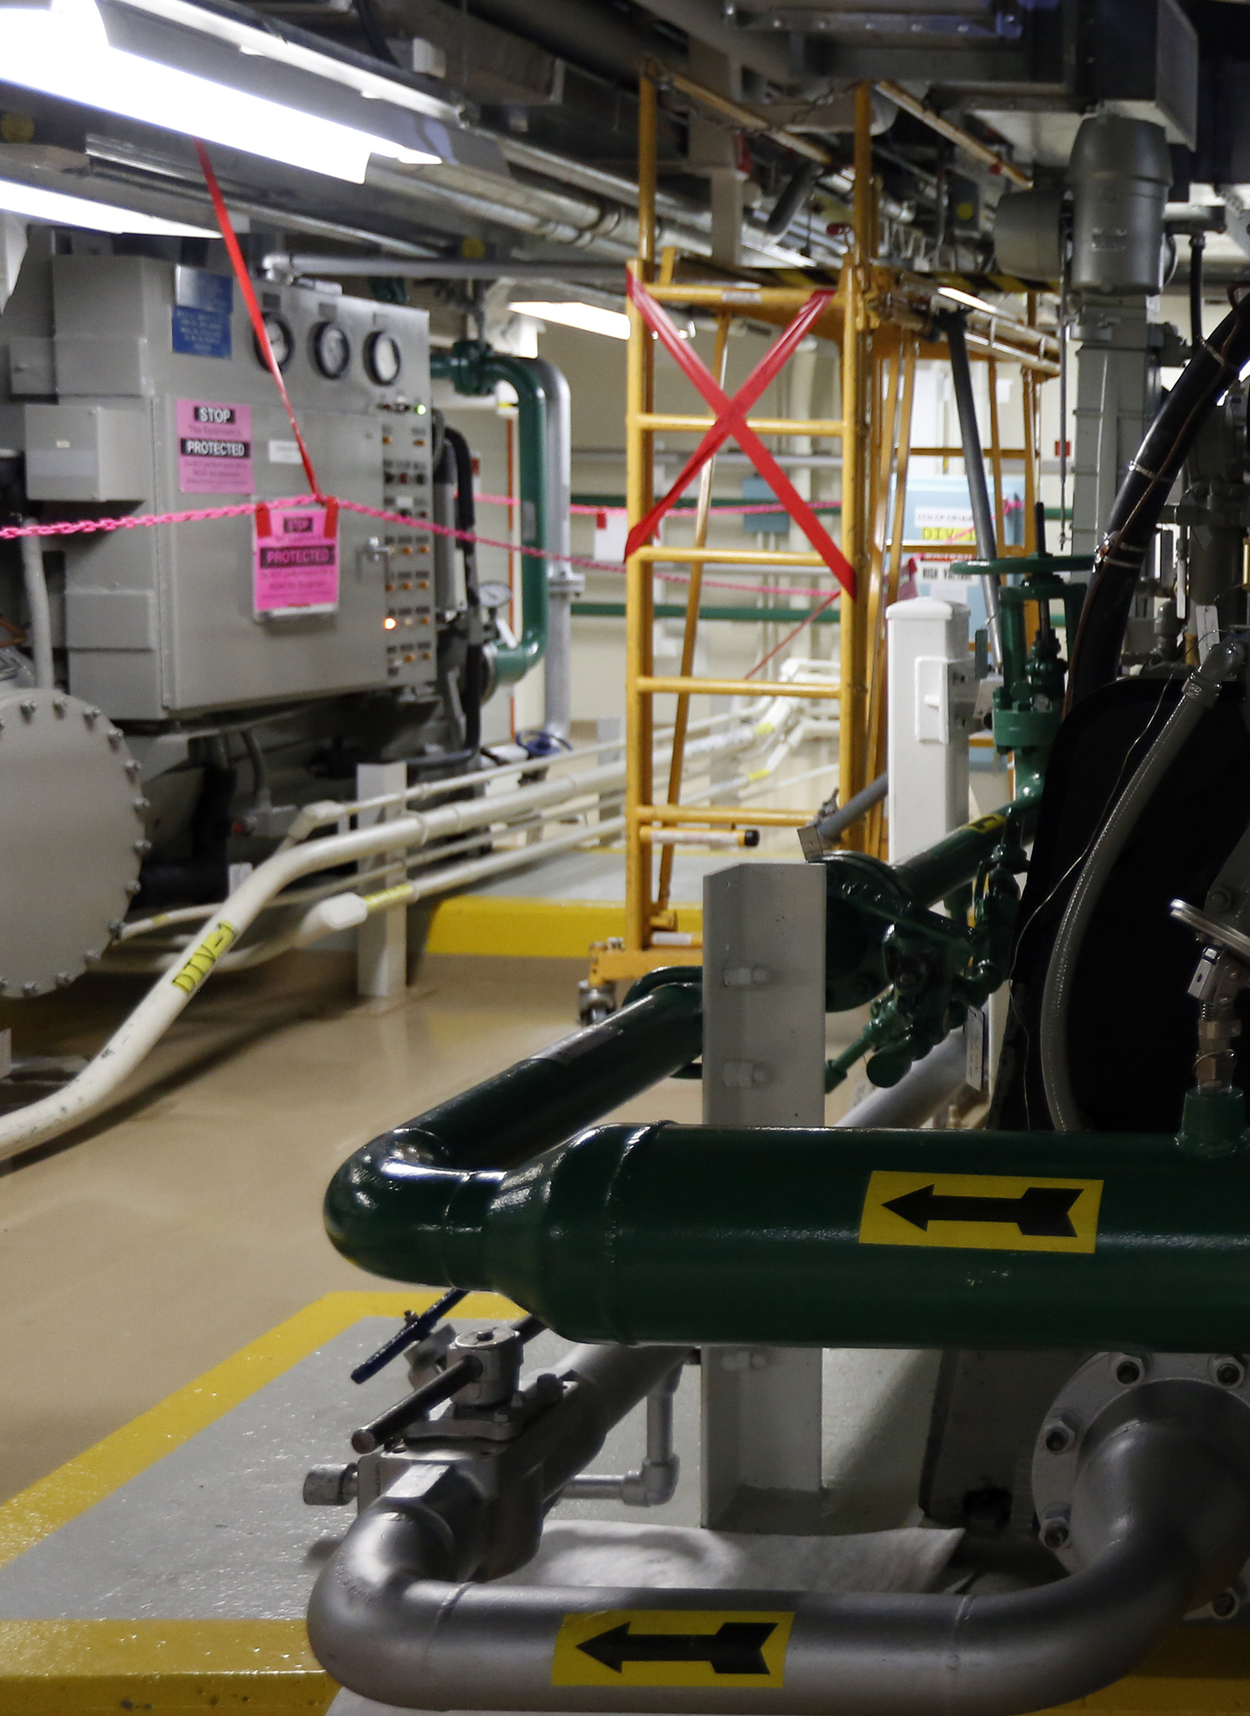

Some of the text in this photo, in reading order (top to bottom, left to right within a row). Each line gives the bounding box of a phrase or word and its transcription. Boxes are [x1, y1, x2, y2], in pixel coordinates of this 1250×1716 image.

[199, 407, 231, 423] STOP
[187, 440, 245, 456] PROTECTED
[288, 520, 310, 531] STOP
[266, 549, 329, 563] PROTECTED
